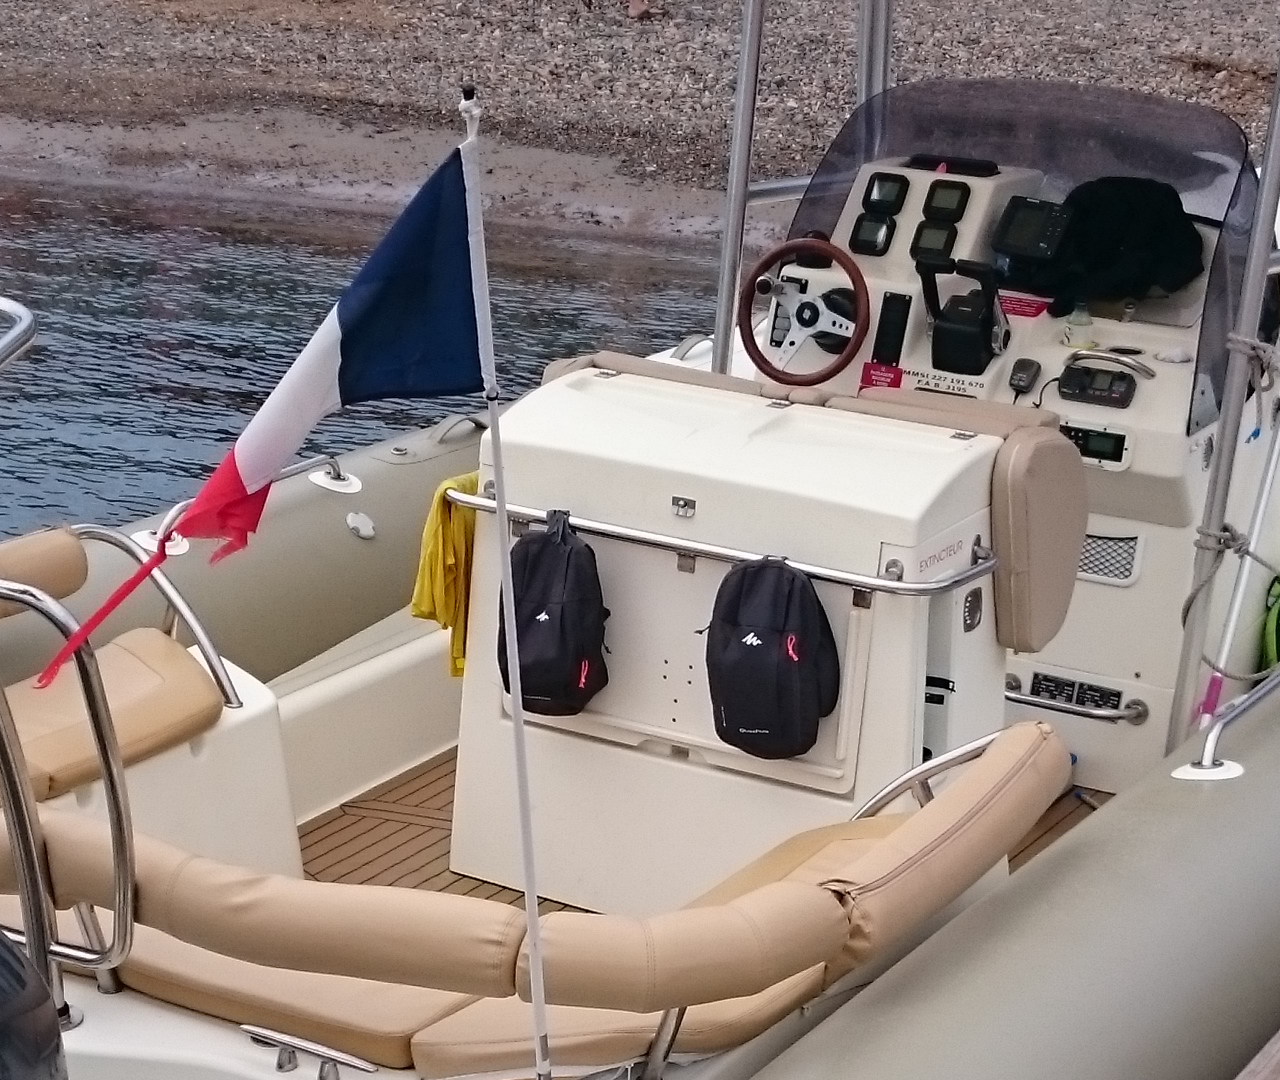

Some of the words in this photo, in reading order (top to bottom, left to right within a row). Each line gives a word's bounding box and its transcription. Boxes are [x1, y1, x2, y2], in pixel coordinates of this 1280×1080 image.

[903, 369, 930, 379] MMSI
[931, 374, 948, 382] 227
[950, 377, 965, 385] 191
